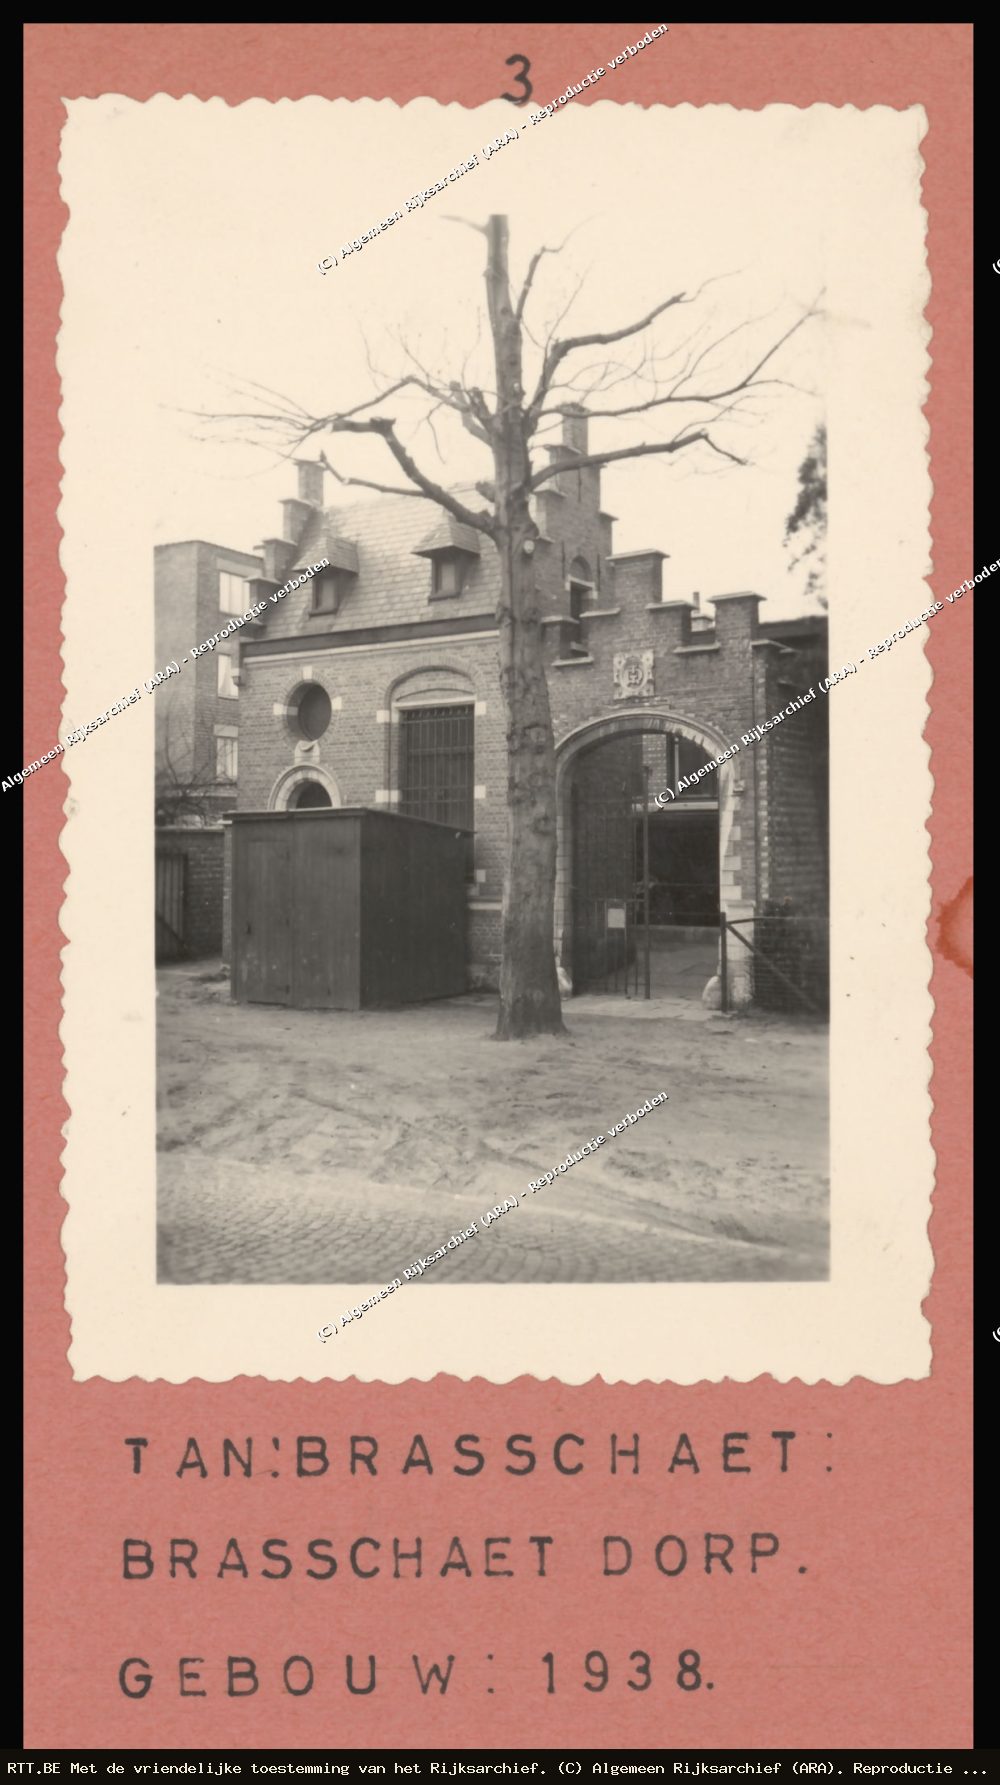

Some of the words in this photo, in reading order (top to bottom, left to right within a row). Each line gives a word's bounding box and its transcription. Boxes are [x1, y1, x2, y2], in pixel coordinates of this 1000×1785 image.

[500, 54, 533, 106] 3
[122, 1536, 554, 1581] BRASSCHAET
[603, 1532, 807, 1578] DORP.
[542, 1649, 715, 1695] 1938.
